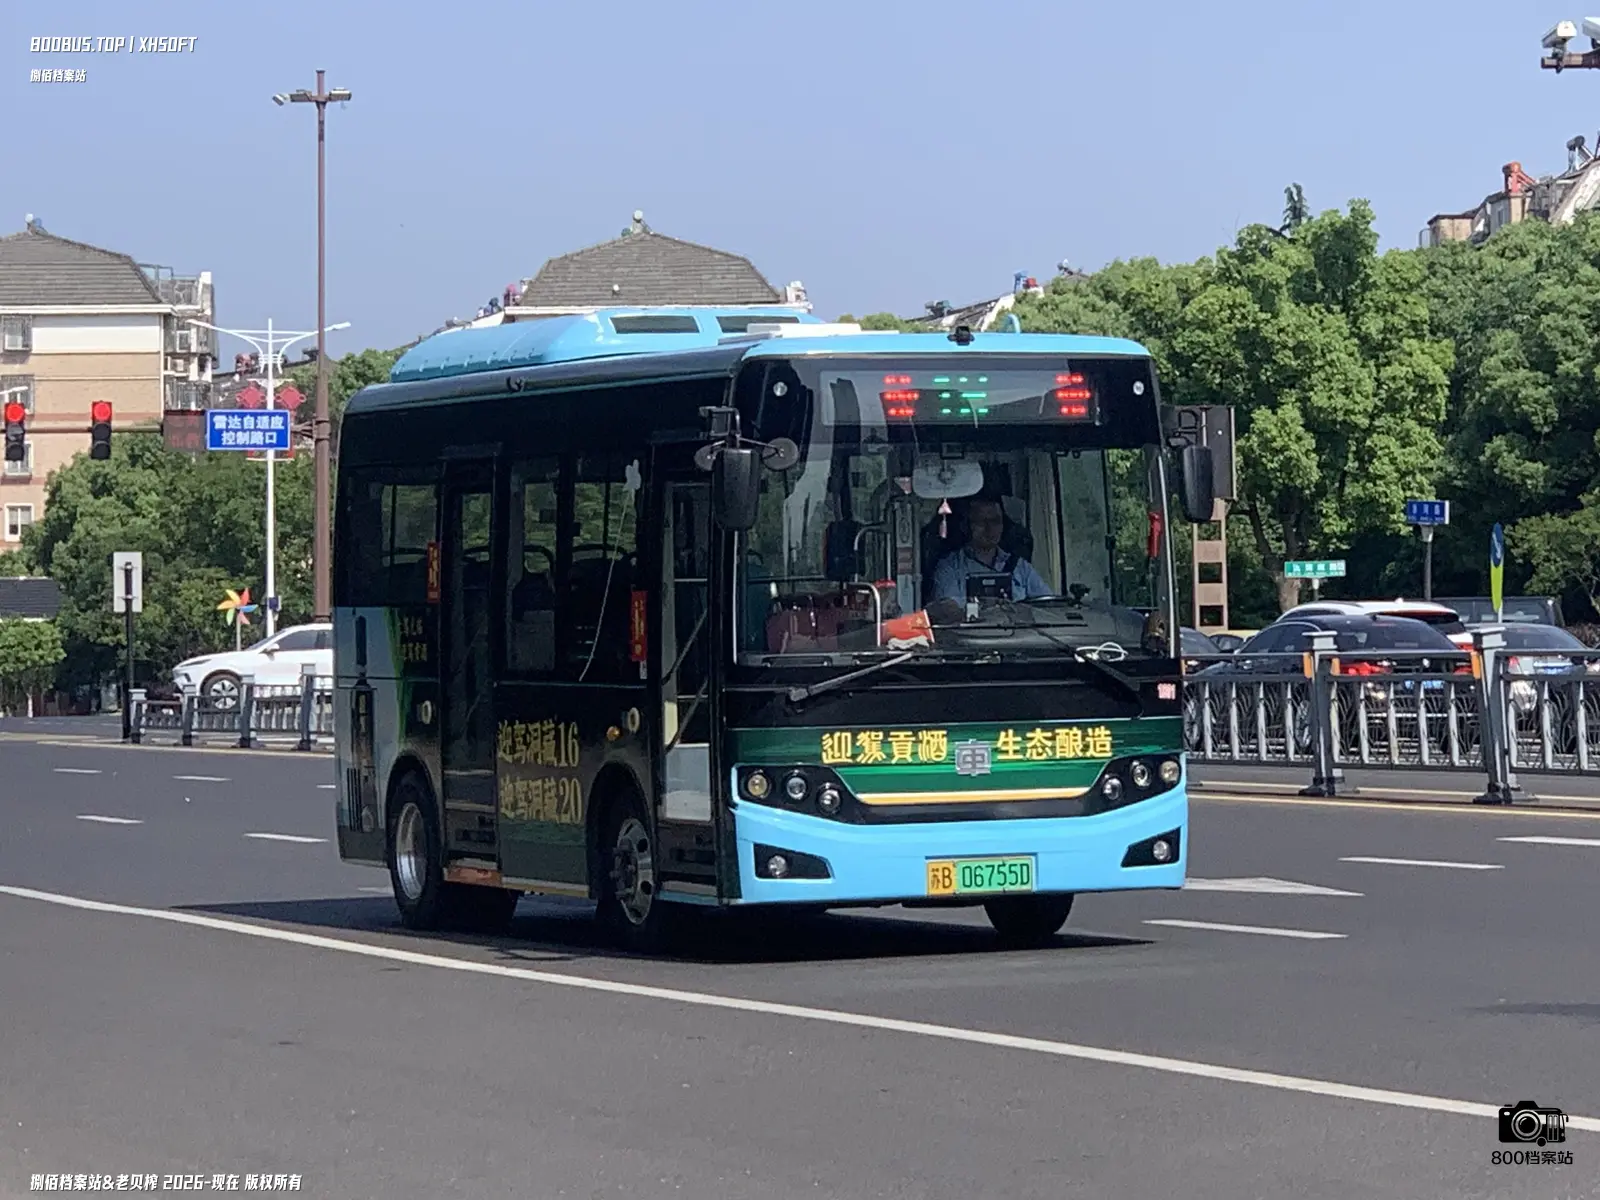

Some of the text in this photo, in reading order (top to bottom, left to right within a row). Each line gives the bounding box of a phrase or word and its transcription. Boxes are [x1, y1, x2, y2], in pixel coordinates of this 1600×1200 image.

[213, 415, 285, 430] 雷达自适应
[221, 431, 278, 446] 控制路口
[997, 725, 1113, 761] 生态酿造
